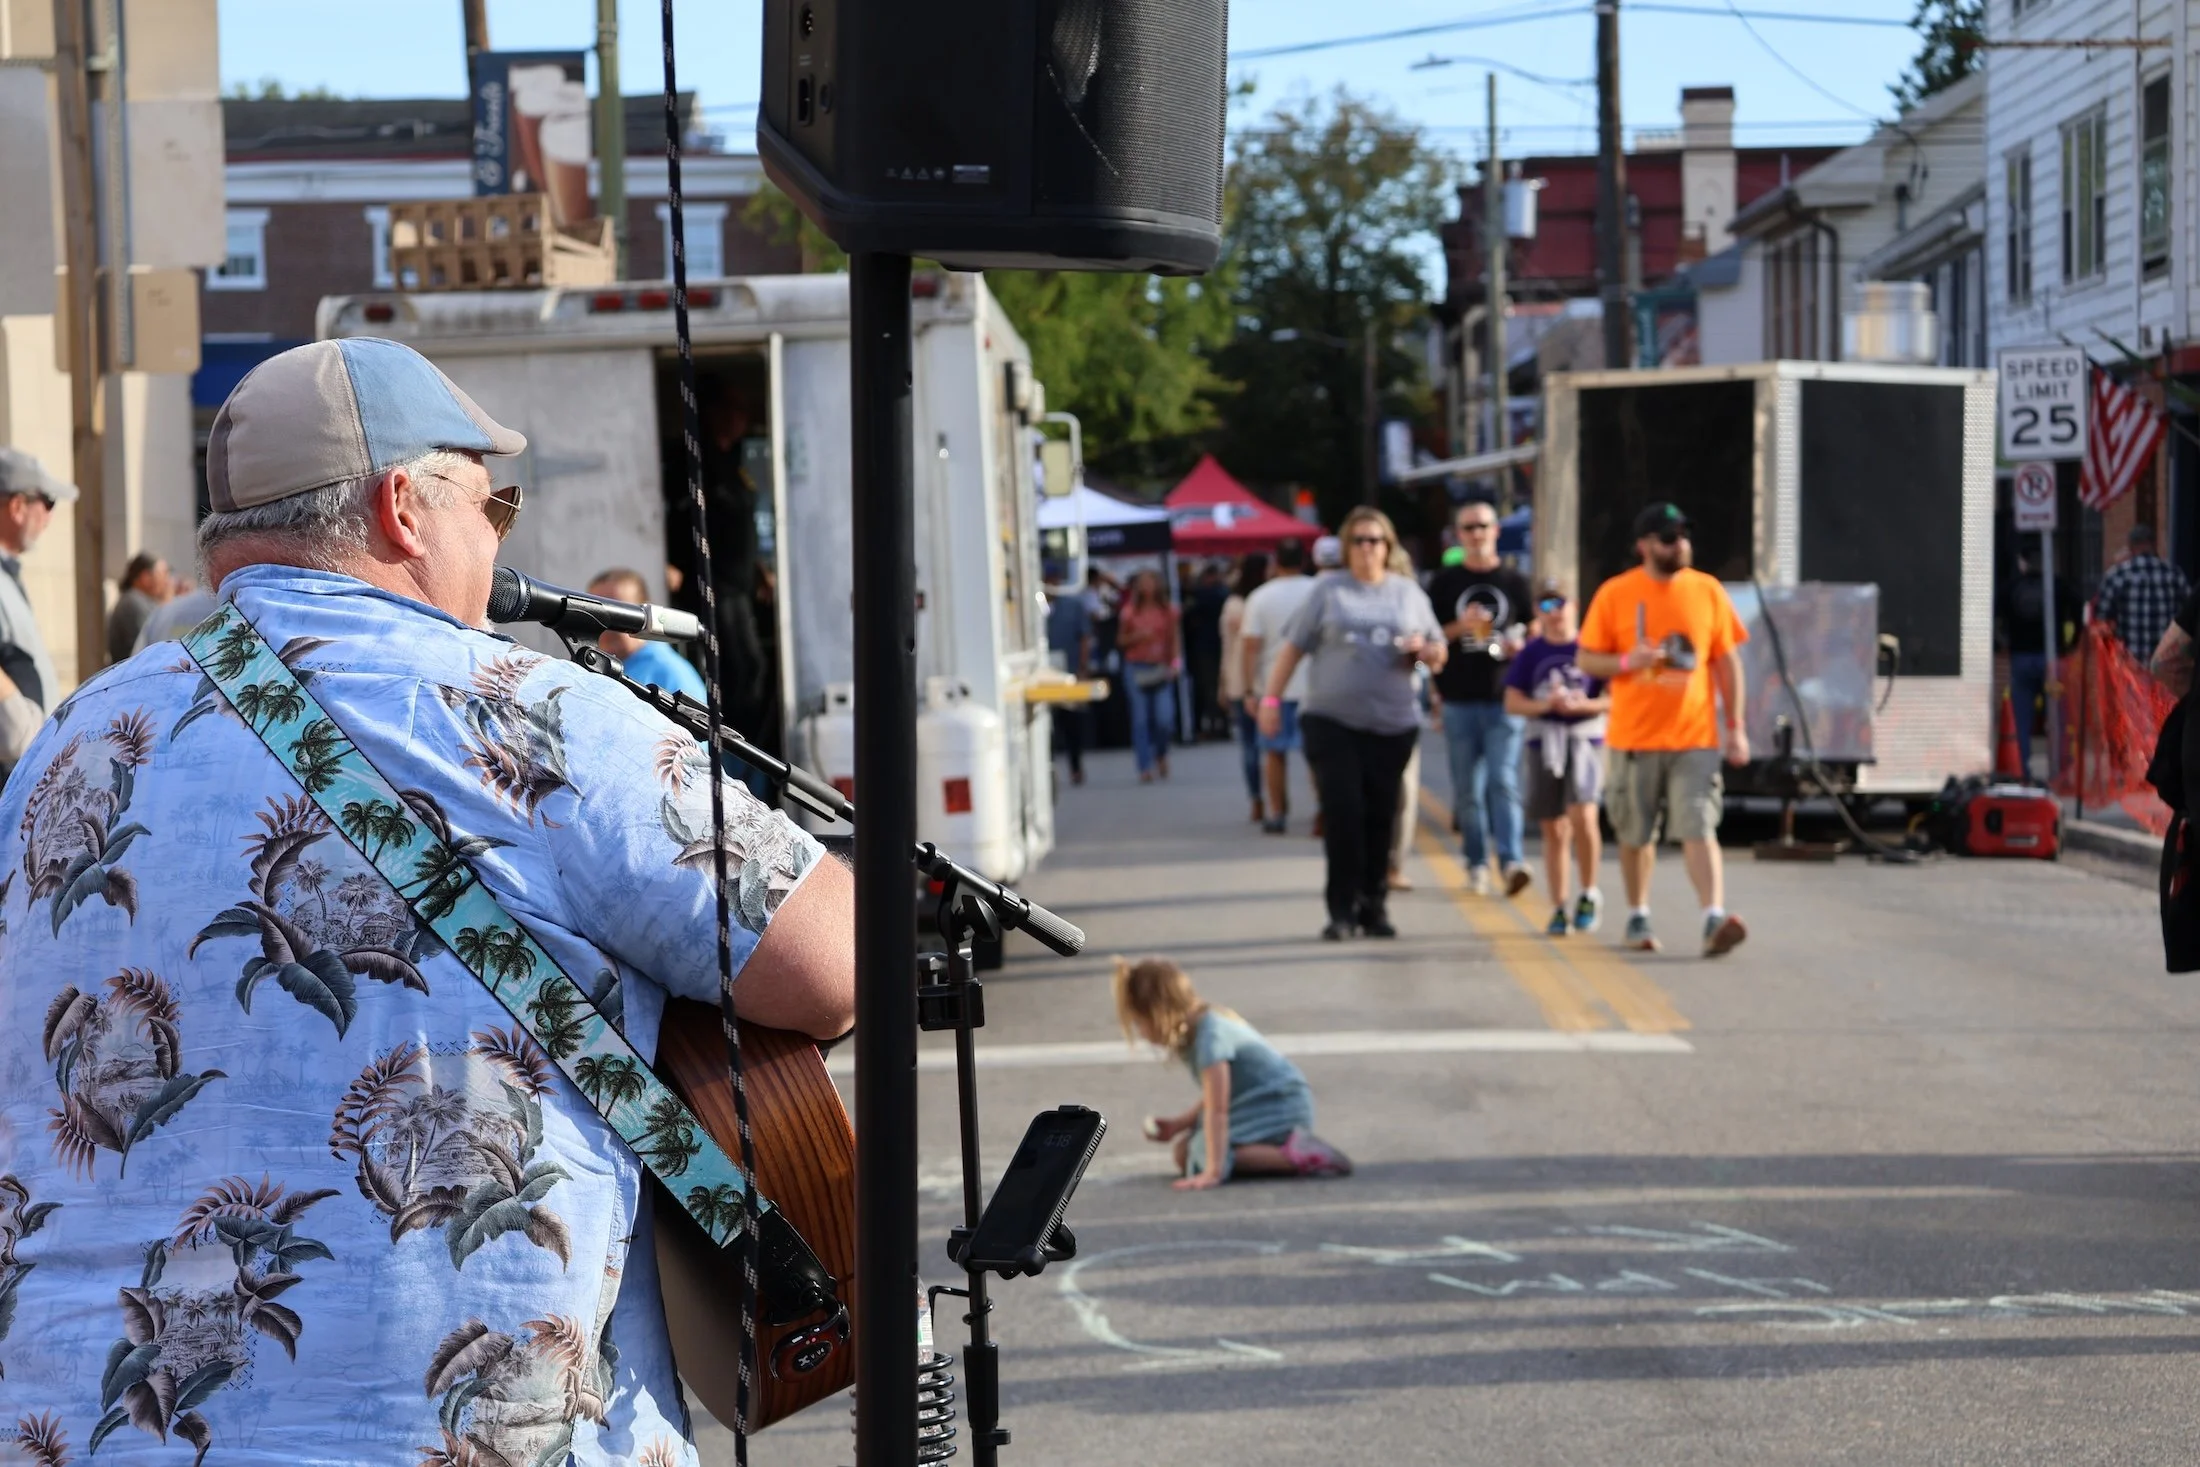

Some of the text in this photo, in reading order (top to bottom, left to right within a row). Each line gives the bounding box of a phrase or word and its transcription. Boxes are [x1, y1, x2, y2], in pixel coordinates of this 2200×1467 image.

[2006, 357, 2079, 382] SPEED
[2014, 381, 2071, 400] LIMIT
[2010, 404, 2079, 446] 25
